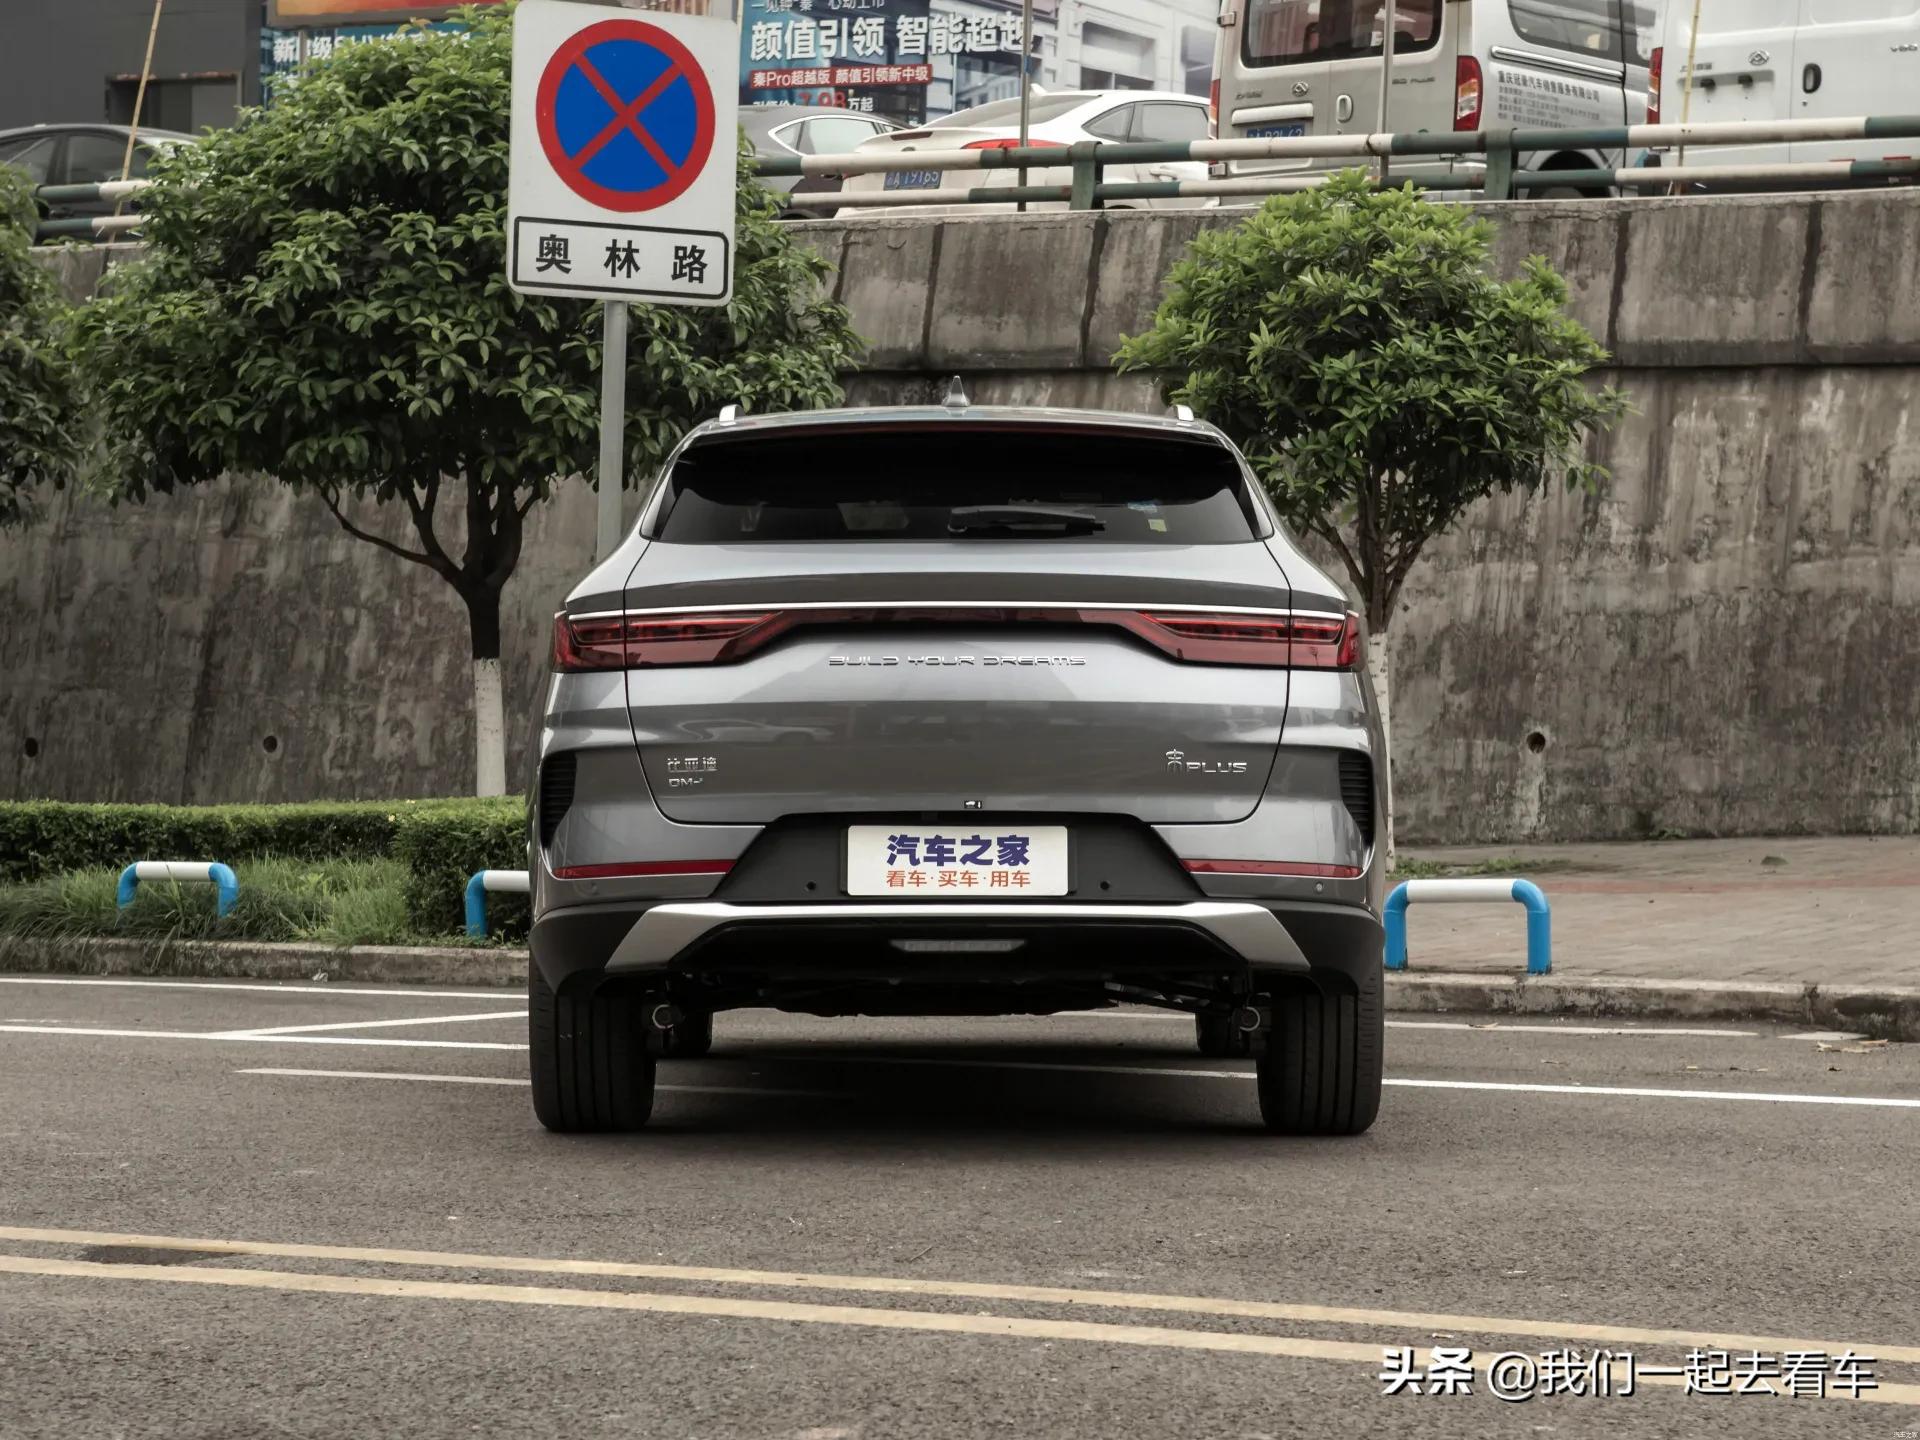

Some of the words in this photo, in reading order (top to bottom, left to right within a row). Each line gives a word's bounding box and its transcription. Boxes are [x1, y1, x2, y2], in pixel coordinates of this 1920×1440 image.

[751, 17, 885, 60] 颜值引领
[895, 11, 1033, 56] 智能超越
[752, 69, 831, 87] 秦Pro超越版
[835, 66, 929, 84] 颜值引领新中级
[536, 234, 708, 284] 奥林路
[829, 656, 899, 666] BUILD
[908, 656, 975, 666] YOUR
[983, 656, 1086, 666] DREAMS
[886, 834, 1030, 867] 汽车之家
